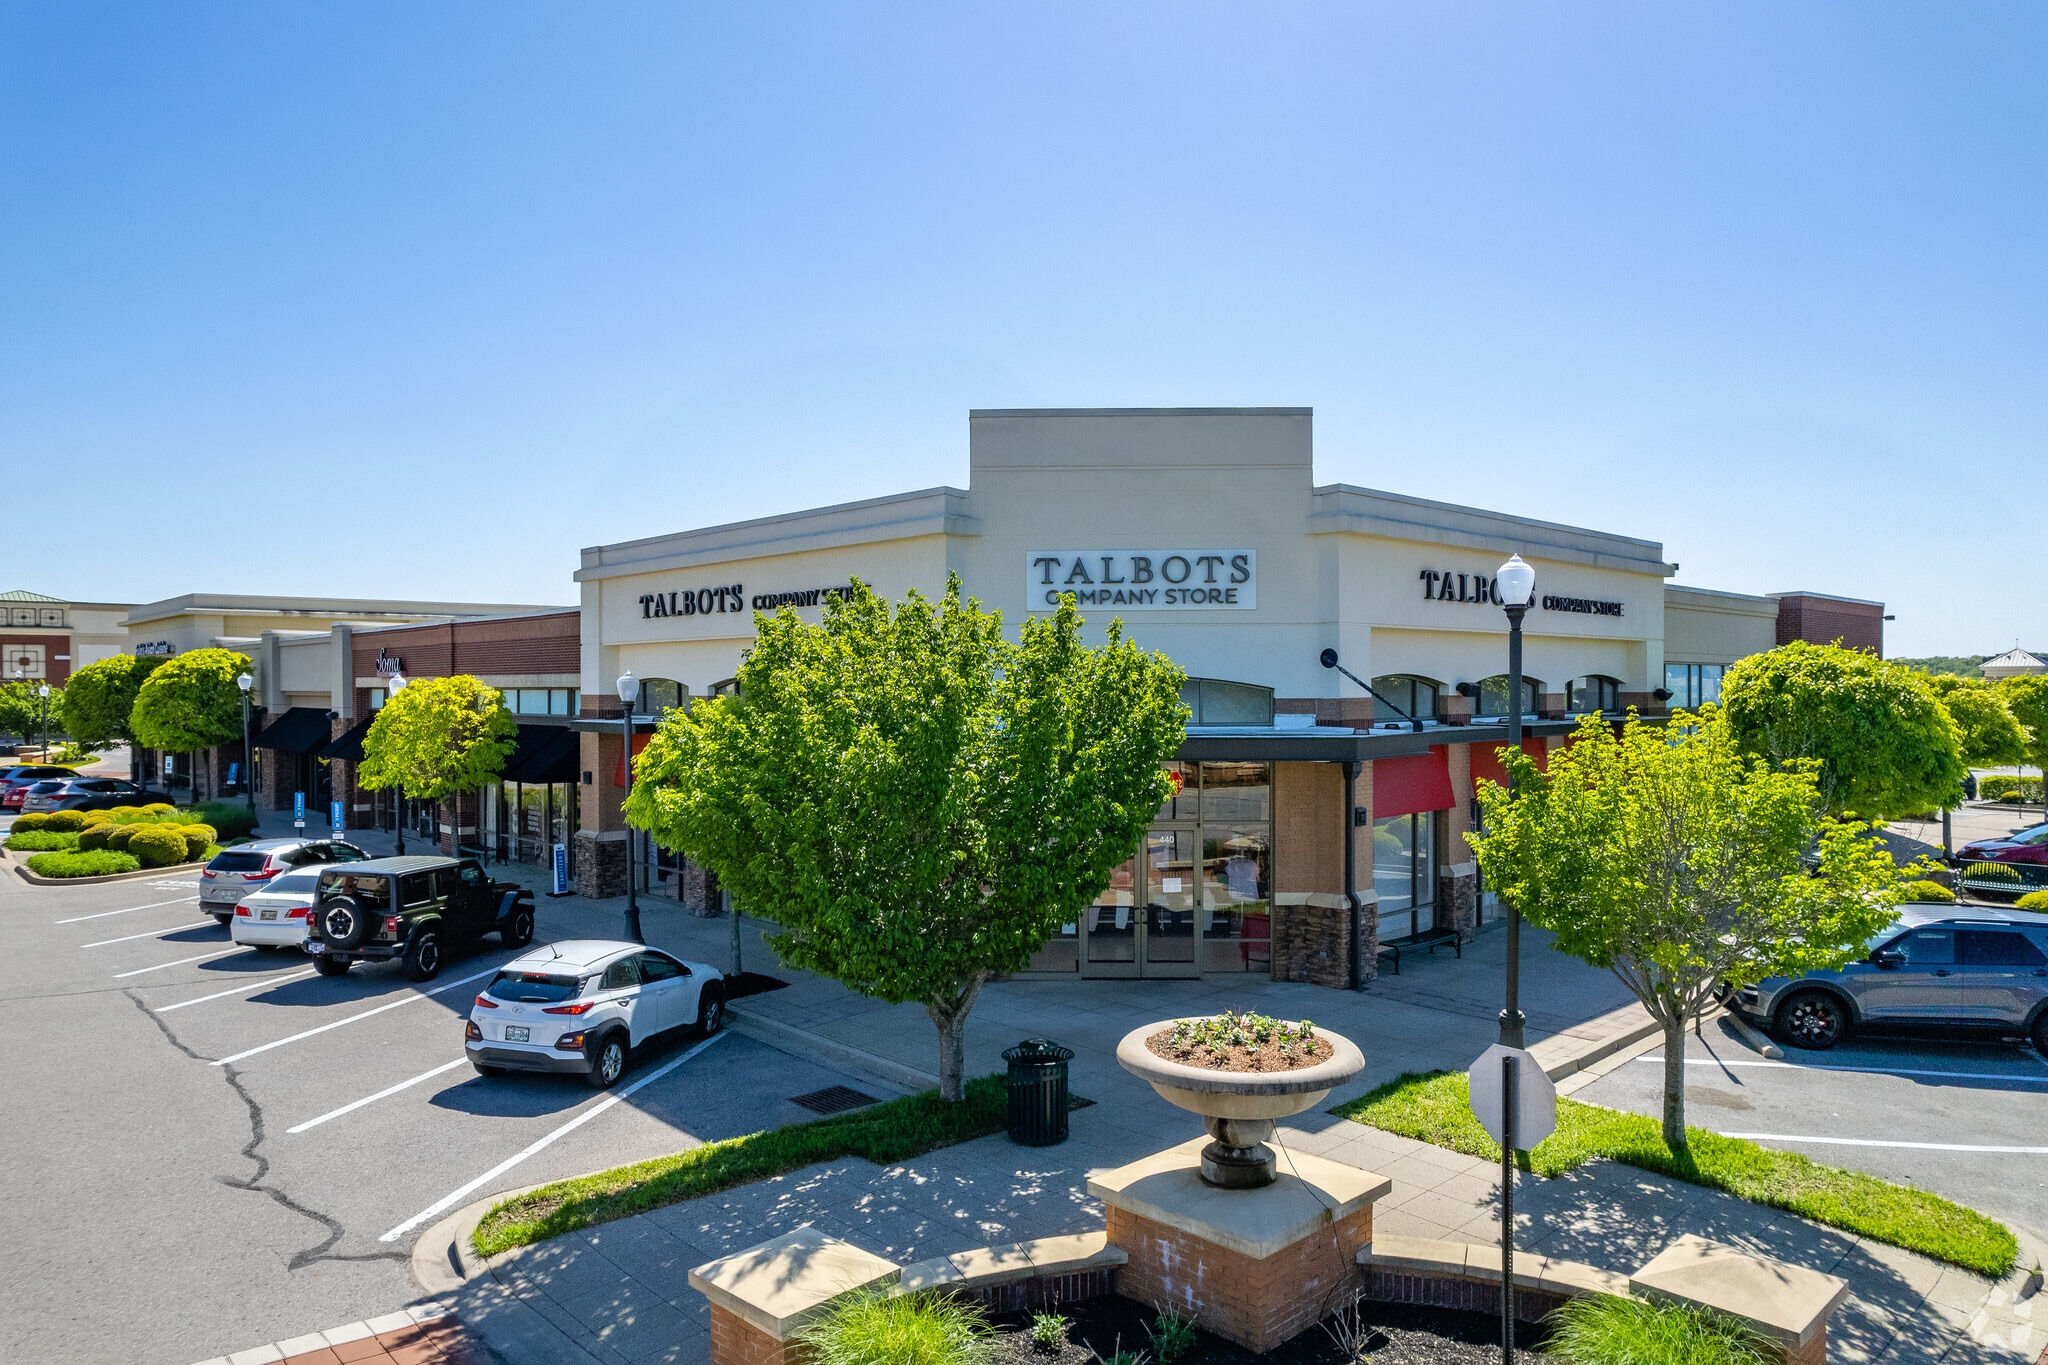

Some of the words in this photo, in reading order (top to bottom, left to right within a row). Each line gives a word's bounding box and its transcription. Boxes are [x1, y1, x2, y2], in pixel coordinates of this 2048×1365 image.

[1033, 554, 1251, 584] TALBOTS
[639, 584, 744, 619] TALBOTS
[752, 589, 821, 610] COMPANY
[821, 584, 872, 605] SOR
[1165, 587, 1239, 604] STORE
[1419, 569, 1537, 609] TALBO
[1542, 595, 1594, 614] COMPANY
[1592, 600, 1625, 617] STORE
[375, 647, 402, 673] Soma
[1159, 835, 1175, 844] 440
